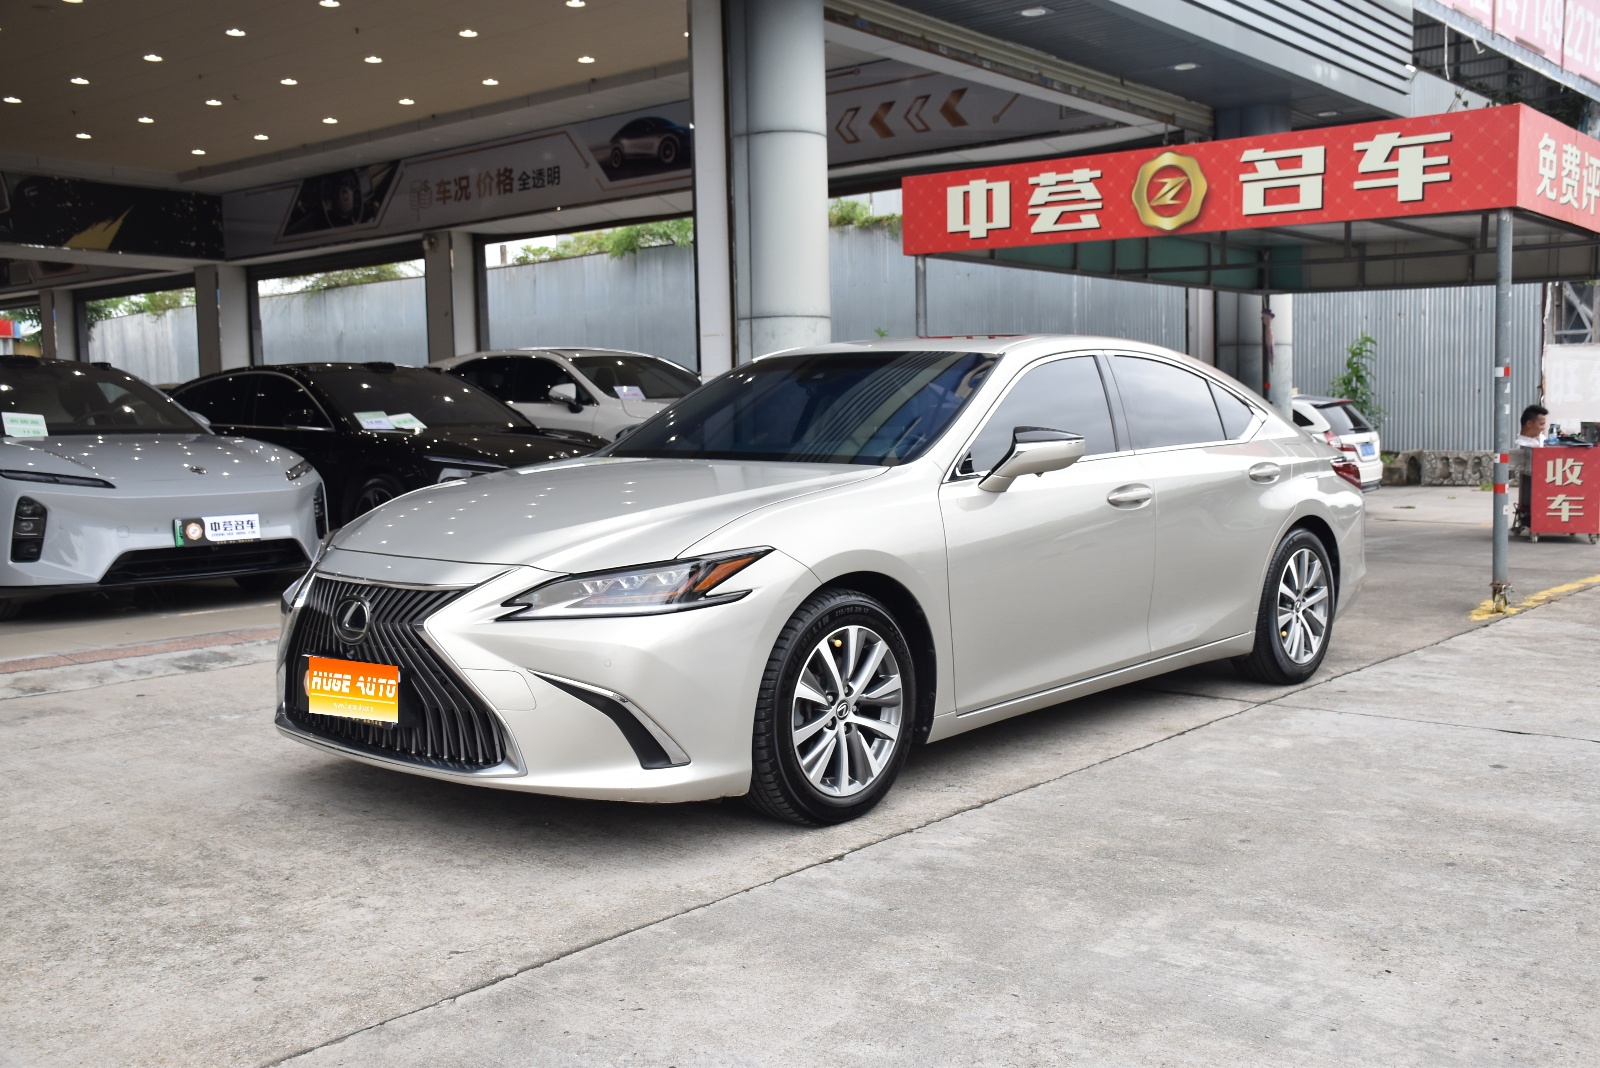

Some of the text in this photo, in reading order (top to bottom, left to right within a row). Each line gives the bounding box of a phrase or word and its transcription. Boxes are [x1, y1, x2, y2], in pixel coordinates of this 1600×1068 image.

[435, 165, 561, 205] 车况 价格 全透明
[946, 131, 1451, 239] 中荟 名车
[1536, 132, 1600, 215] 免费评
[1545, 458, 1585, 522] 收车
[210, 519, 256, 532] 中荟名车
